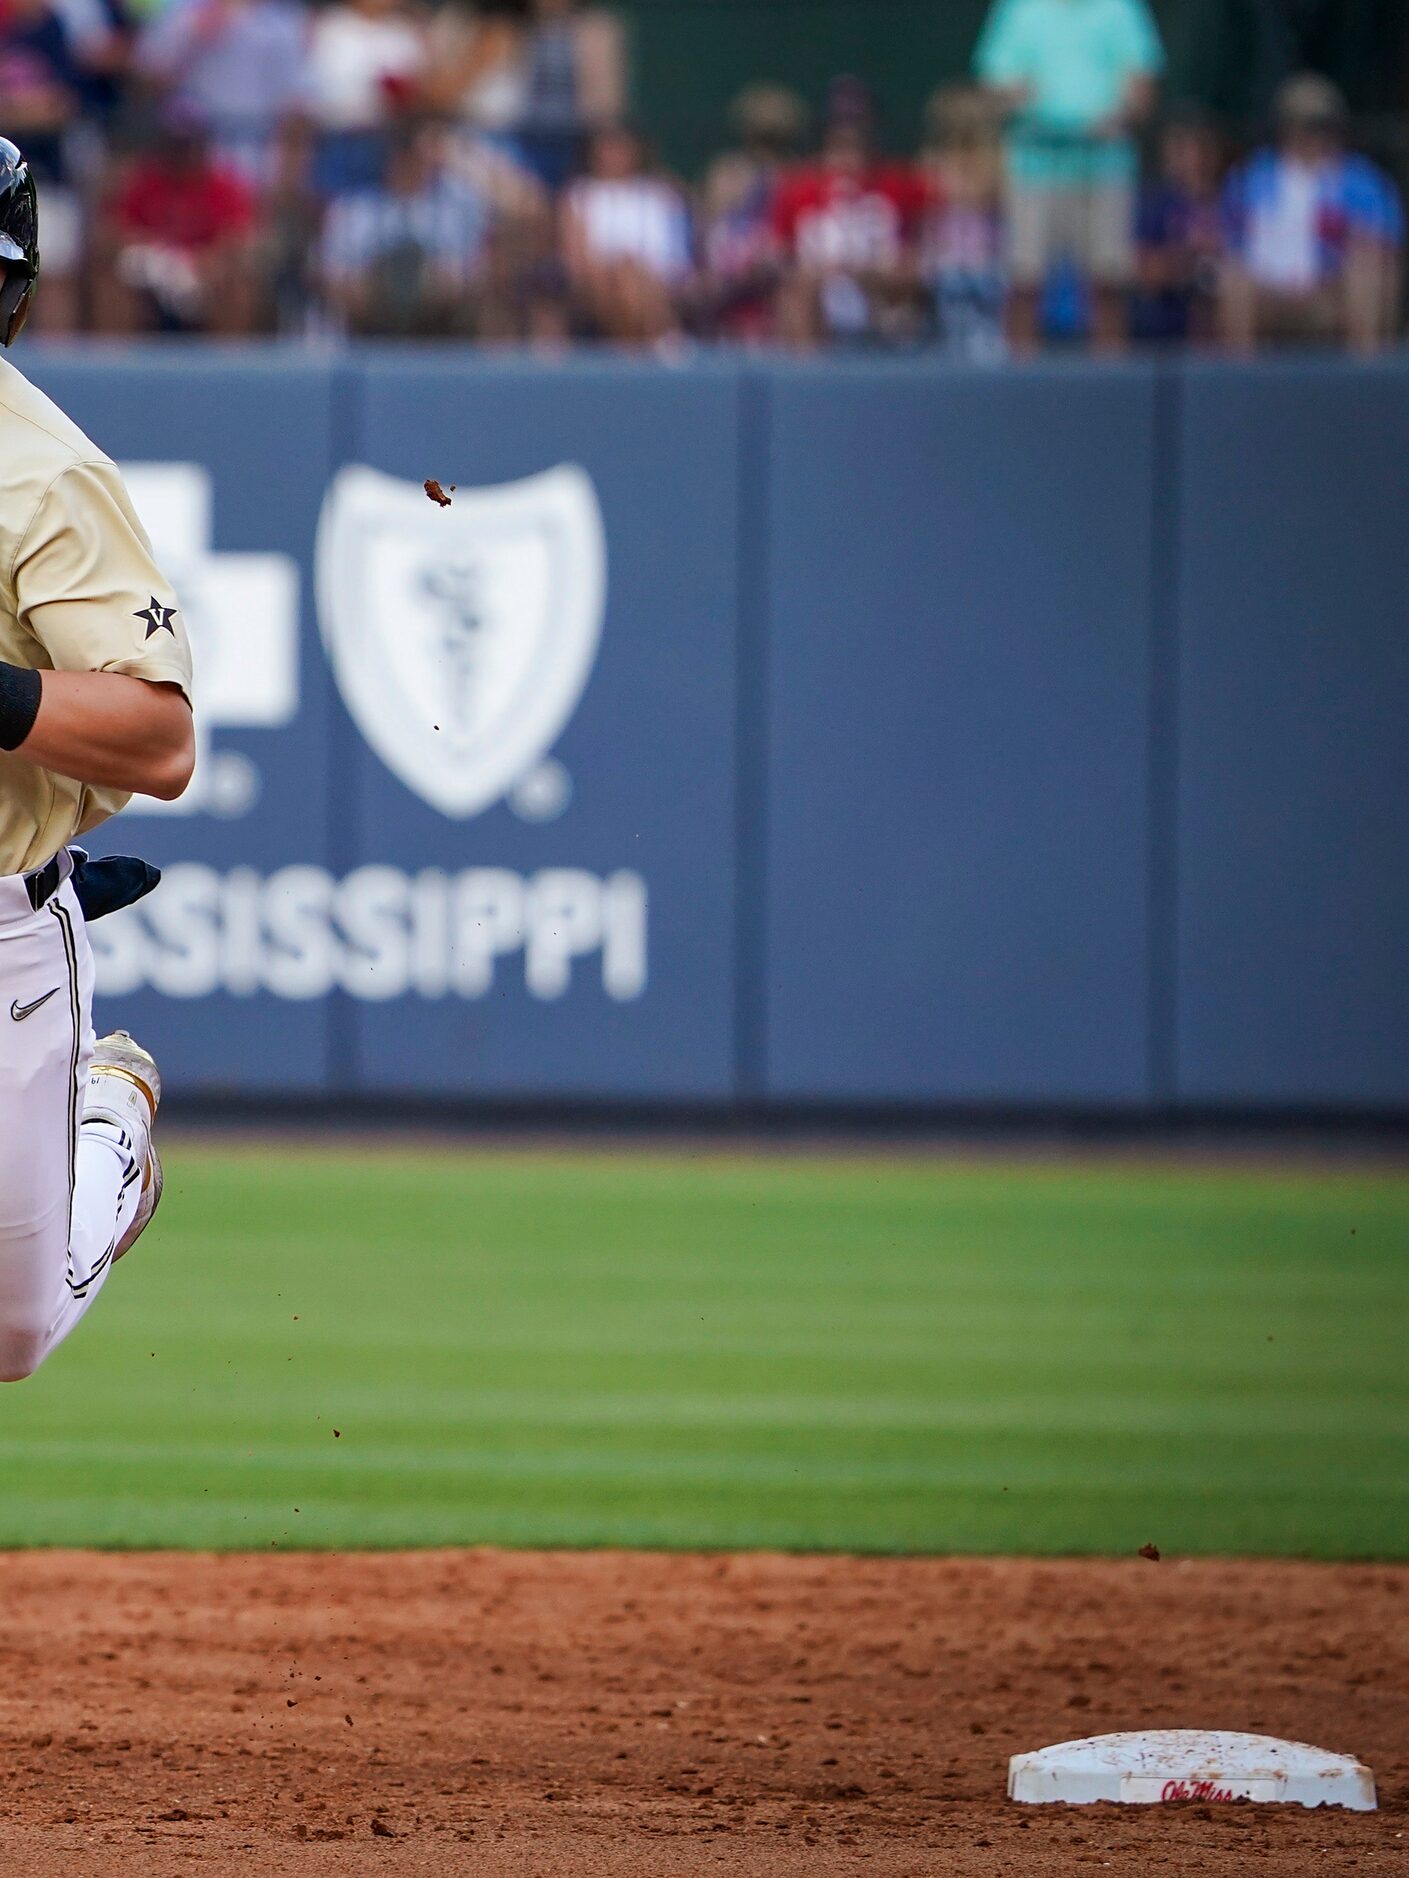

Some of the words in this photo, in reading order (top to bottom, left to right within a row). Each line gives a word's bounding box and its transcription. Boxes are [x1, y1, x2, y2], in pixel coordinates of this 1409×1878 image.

[148, 608, 165, 626] V
[89, 864, 648, 1001] SSISSIPPI
[1161, 1779, 1190, 1802] Ole
[1190, 1780, 1233, 1801] Miss
